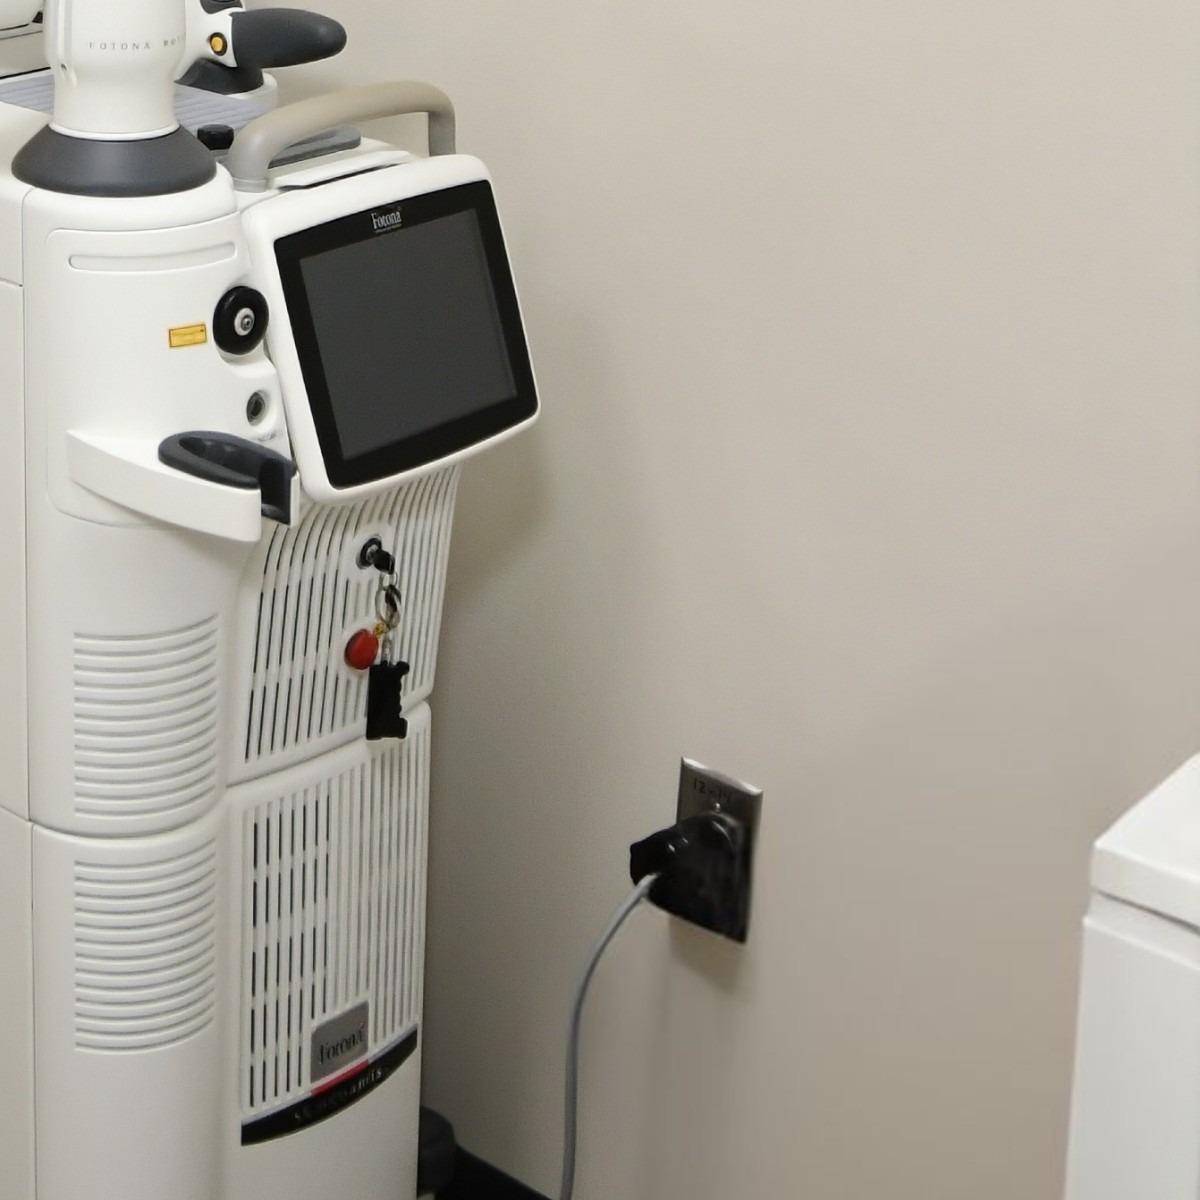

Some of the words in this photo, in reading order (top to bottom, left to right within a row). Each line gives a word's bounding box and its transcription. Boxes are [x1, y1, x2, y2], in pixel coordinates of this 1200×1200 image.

[89, 41, 151, 51] FOTONA
[370, 211, 402, 229] Fotona
[319, 1030, 364, 1064] Fotona
